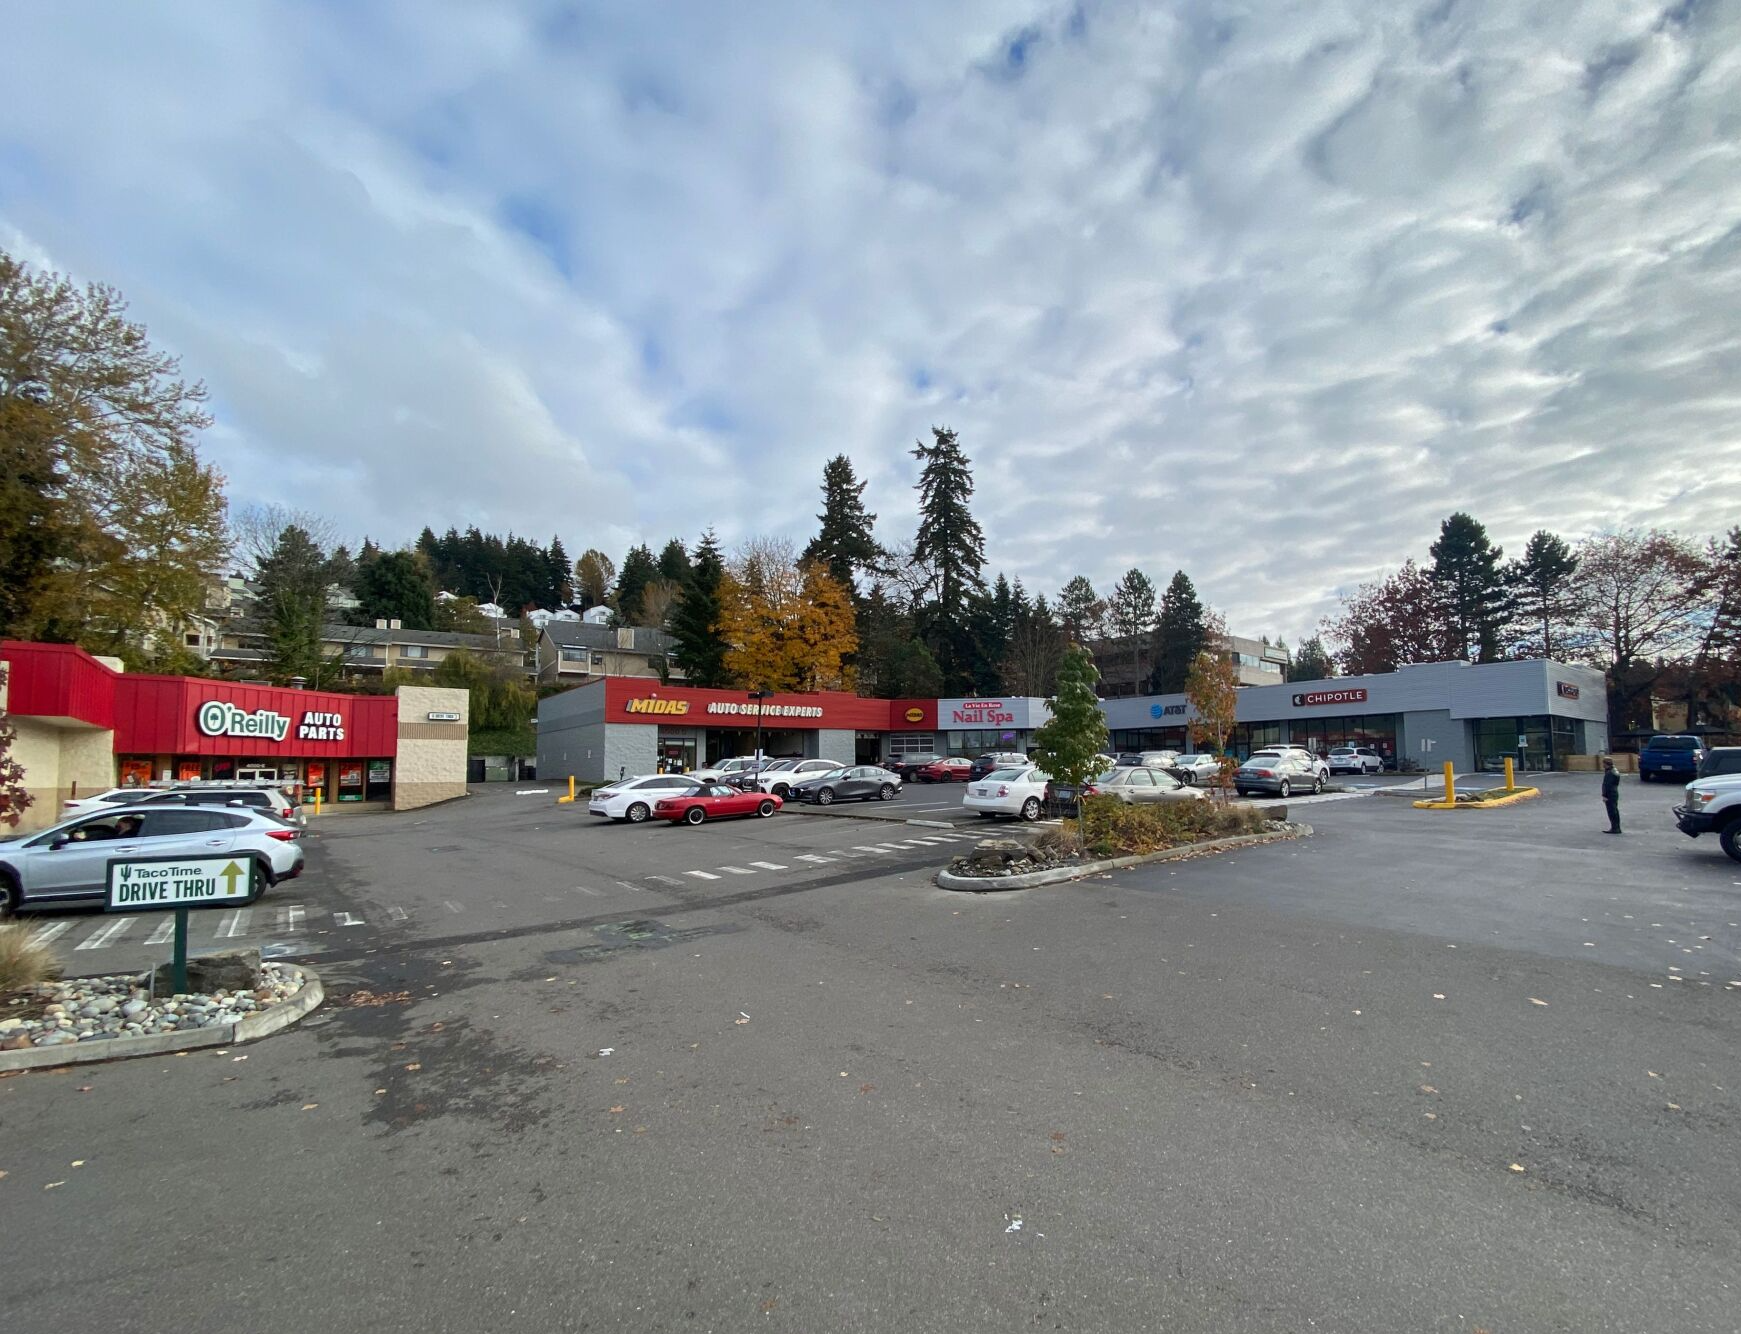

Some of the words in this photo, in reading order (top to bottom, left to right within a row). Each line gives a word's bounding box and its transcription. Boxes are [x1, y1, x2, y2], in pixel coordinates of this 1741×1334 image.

[1307, 691, 1363, 703] CHIPOTLE
[628, 698, 689, 714] MIDAS
[707, 702, 738, 714] AUTO
[740, 703, 781, 716] SERVICE
[783, 705, 823, 717] EXPERTS
[1164, 705, 1187, 716] AT&T
[201, 702, 289, 740] O'Reilly
[304, 711, 342, 726] AUTO
[953, 710, 984, 723] Nail
[986, 709, 1014, 726] Spa
[300, 725, 345, 741] PARTS
[119, 881, 168, 902] DRIVE
[173, 878, 216, 898] THRU
